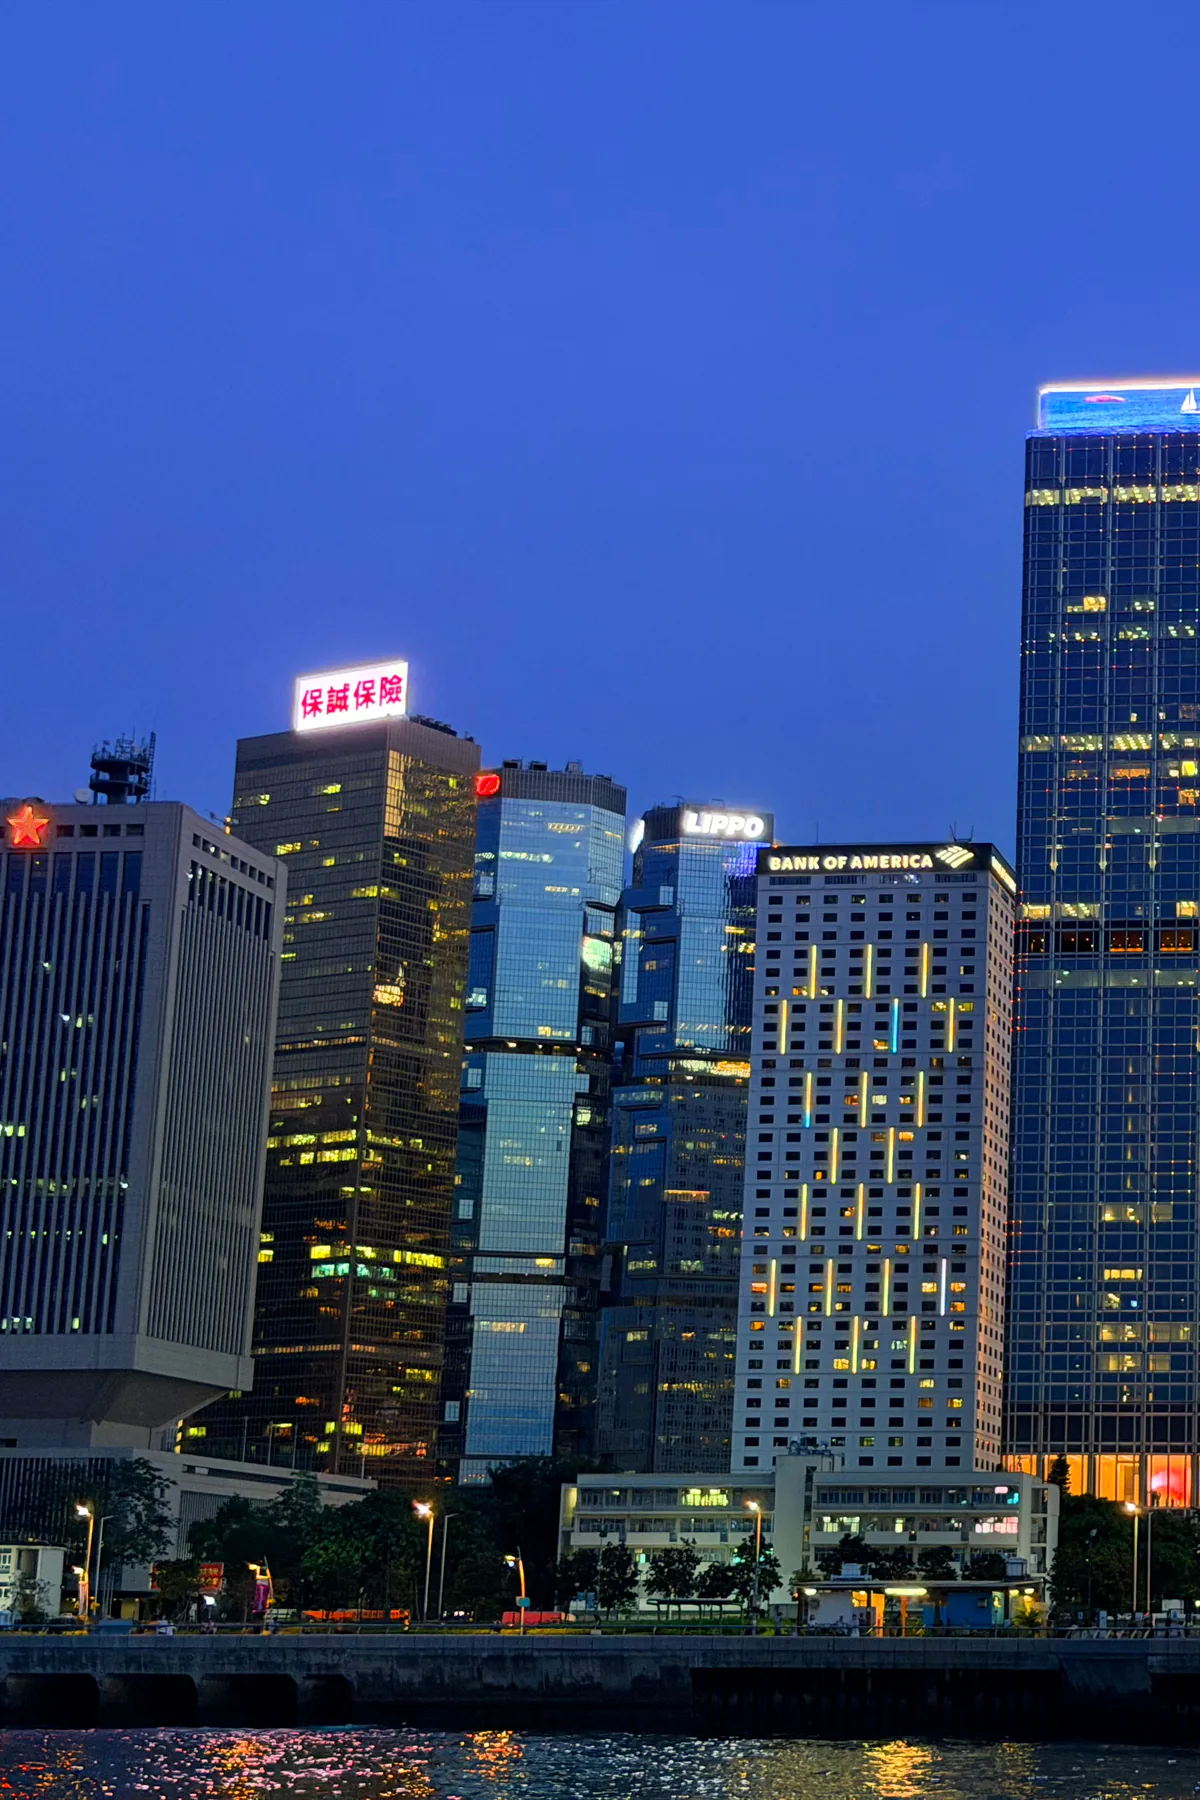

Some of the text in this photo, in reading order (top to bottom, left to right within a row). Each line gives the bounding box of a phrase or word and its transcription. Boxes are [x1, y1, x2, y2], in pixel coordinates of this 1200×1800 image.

[301, 674, 404, 719] 保誠保險
[684, 810, 765, 838] LIPPO
[769, 854, 933, 871] BANK OF AMERICA
